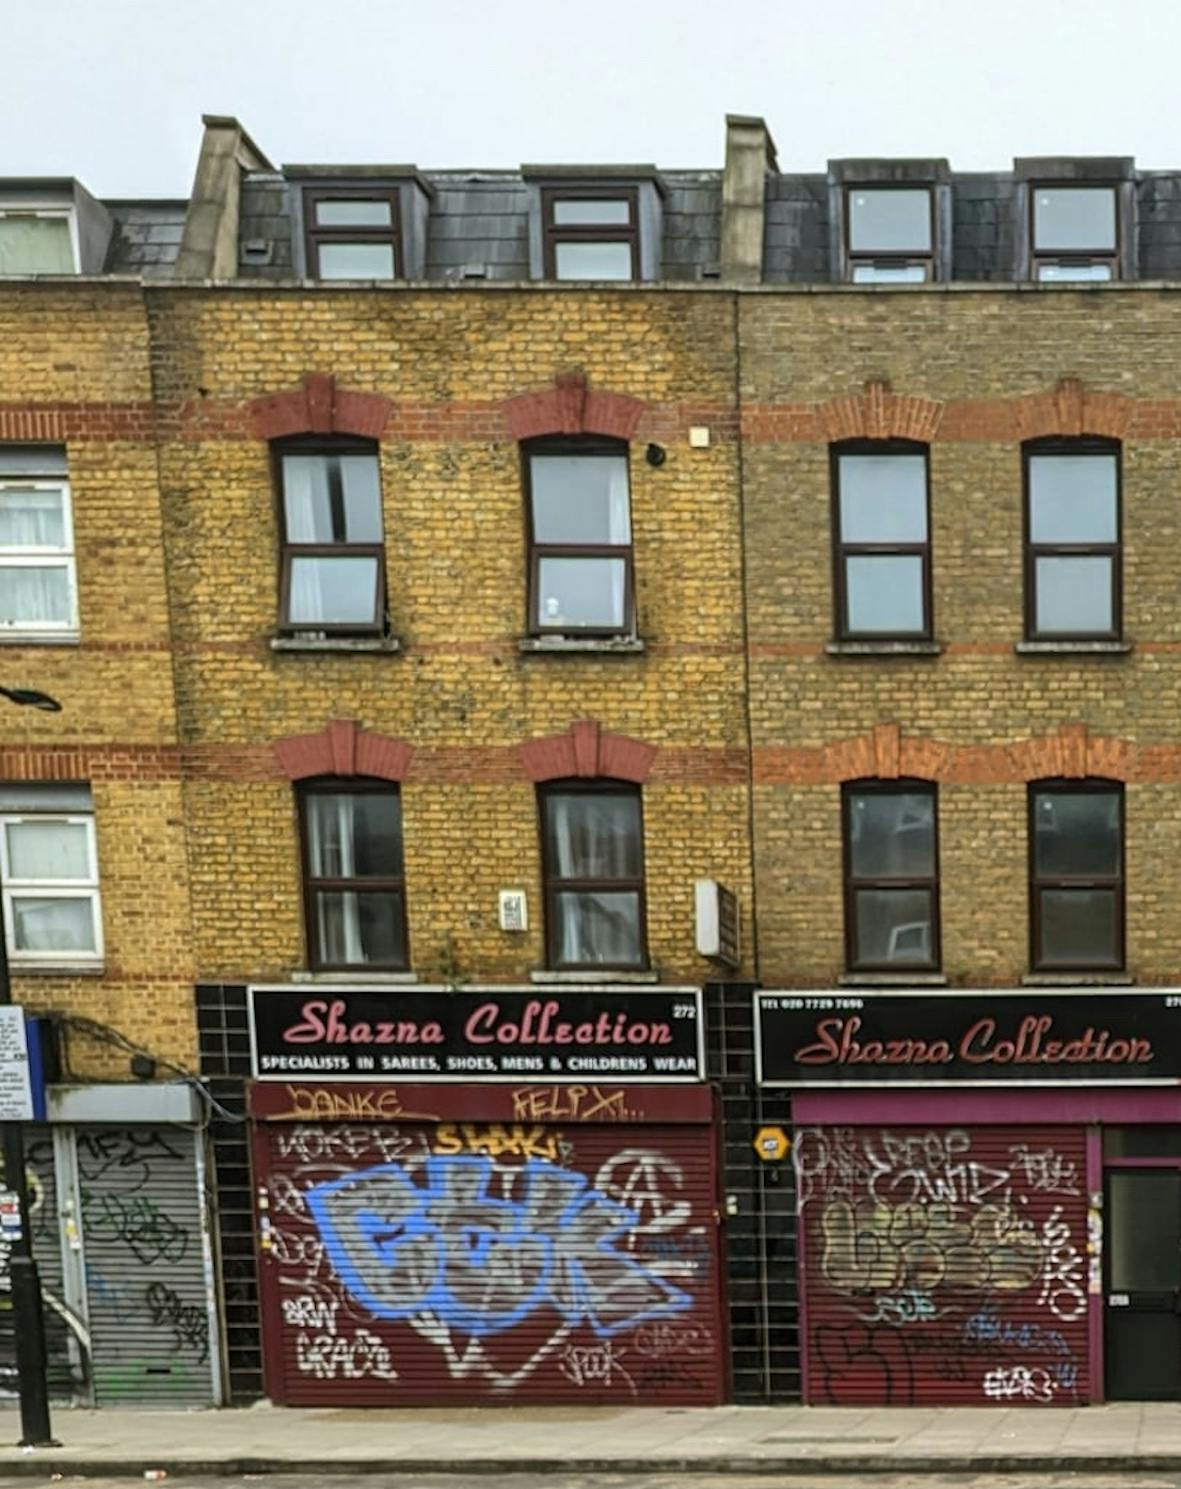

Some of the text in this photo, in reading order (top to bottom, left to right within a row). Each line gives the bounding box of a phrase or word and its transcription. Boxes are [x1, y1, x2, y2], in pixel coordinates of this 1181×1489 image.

[284, 1000, 673, 1044] Shazna Collection
[673, 1005, 696, 1018] 272
[793, 1014, 1154, 1063] Shazna Collection
[261, 1055, 697, 1072] SPECIALISTS IN SAREES, SHOES, MENS & CHILDRENS WEAR
